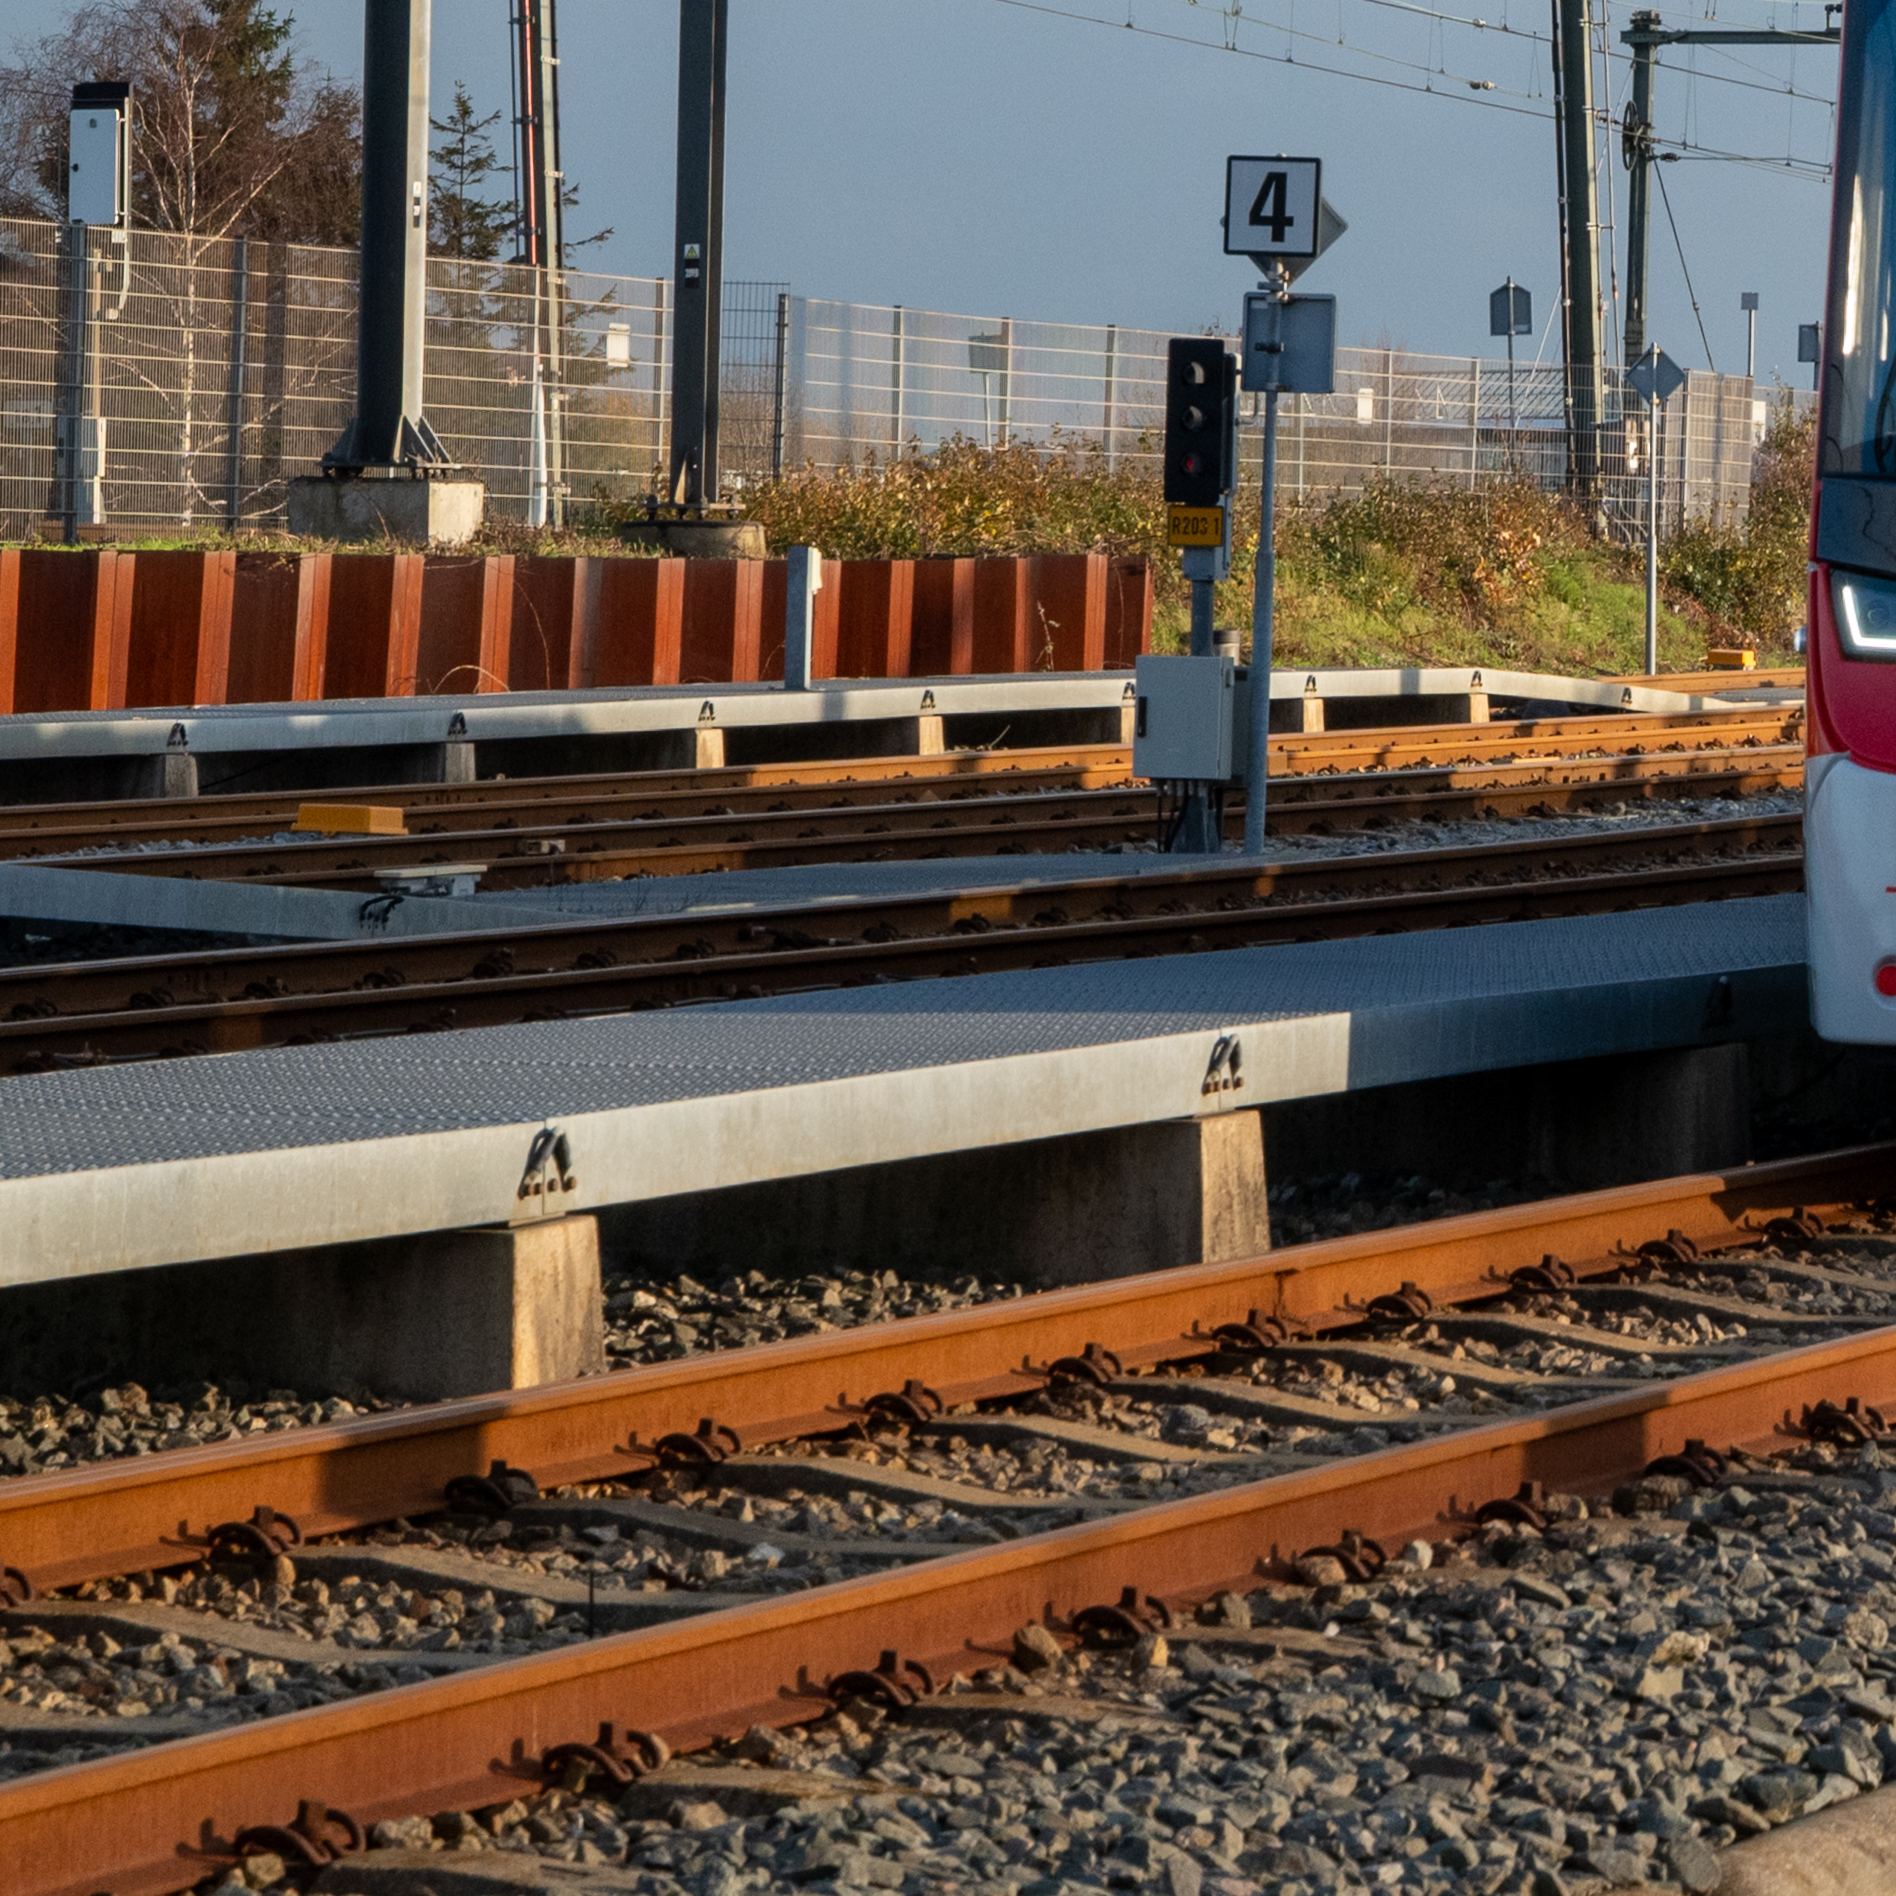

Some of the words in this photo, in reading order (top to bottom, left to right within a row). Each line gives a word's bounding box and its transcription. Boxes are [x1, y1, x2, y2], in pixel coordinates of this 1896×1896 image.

[1248, 171, 1294, 243] 4
[1172, 516, 1208, 535] R203
[1213, 517, 1220, 535] 1
